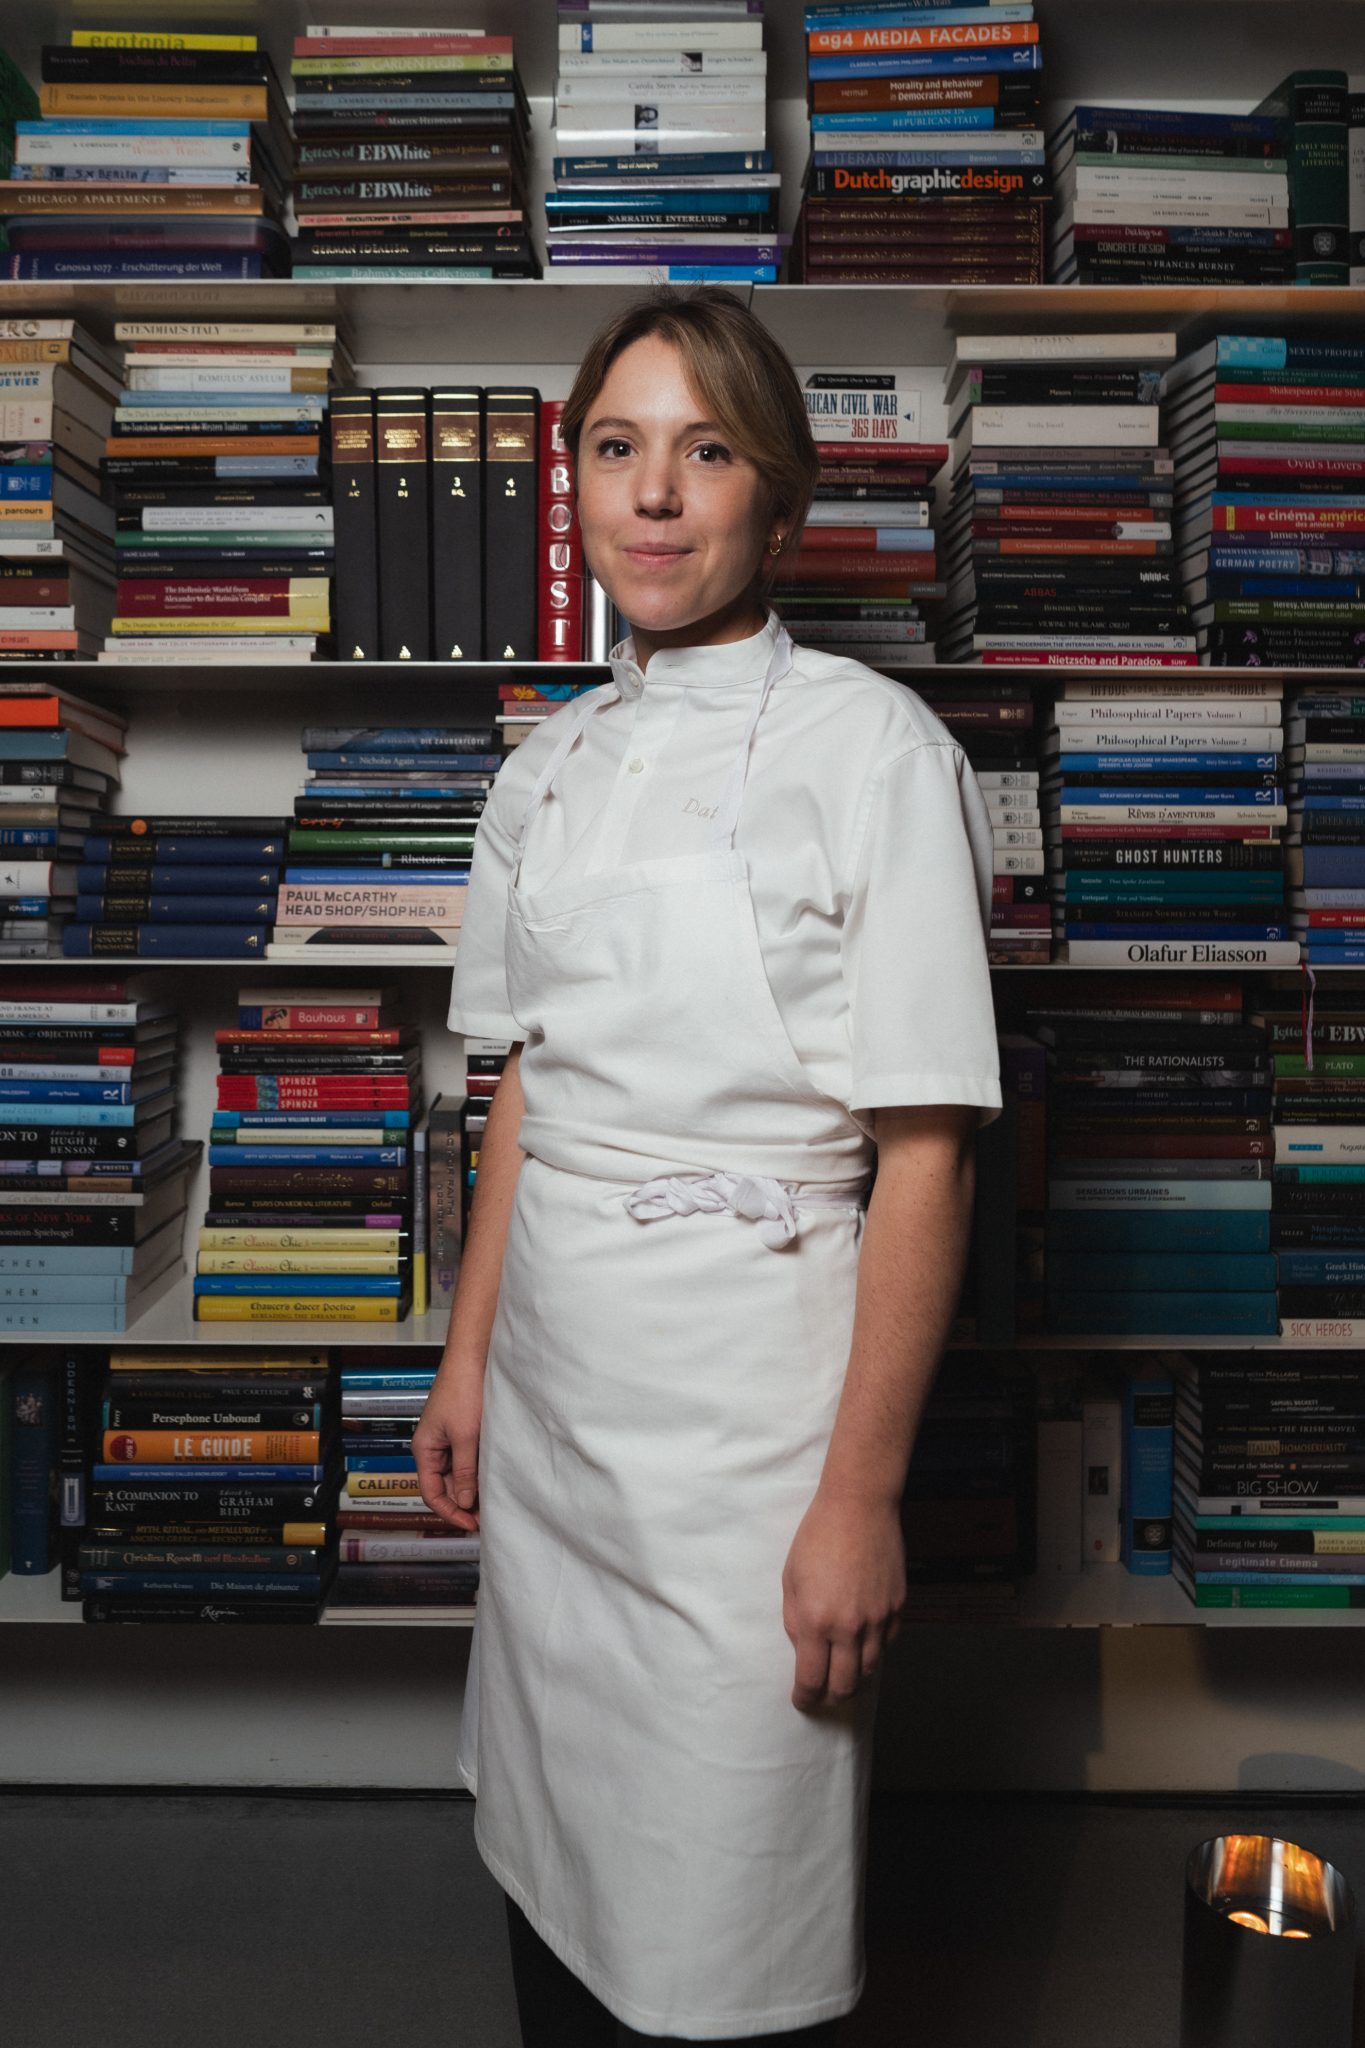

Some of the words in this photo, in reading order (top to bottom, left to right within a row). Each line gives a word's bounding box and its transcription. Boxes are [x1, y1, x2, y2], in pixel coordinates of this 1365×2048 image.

[819, 31, 854, 50] ag4
[863, 29, 923, 47] MEDIA
[929, 26, 1012, 45] FACADES
[889, 81, 924, 92] Morality
[924, 80, 941, 89] and
[941, 78, 984, 89] Behaviour
[898, 91, 942, 101] Democratic
[942, 89, 973, 99] Athens
[892, 116, 952, 128] REPUBLICAN
[953, 115, 979, 126] ITALY
[342, 145, 355, 159] of
[824, 153, 896, 165] LITERARY
[834, 167, 1024, 194] Dutchgraphicdesign
[343, 182, 356, 196] of
[17, 194, 77, 205] CHICAGO
[82, 194, 167, 205] APARTMENTS
[607, 214, 663, 224] NARRATIVE
[665, 214, 728, 224] INTERLUDES
[1097, 242, 1136, 253] CONCRETE
[1137, 243, 1166, 254] DESIGN
[54, 263, 91, 272] Canossa
[121, 262, 184, 275] Erschütterung
[184, 263, 200, 272] der
[201, 262, 222, 272] Welt
[1153, 259, 1197, 270] FRANCES
[1198, 261, 1236, 272] BURNEY
[191, 324, 221, 336] ITALY
[1324, 387, 1343, 398] Late
[1345, 388, 1364, 399] Style
[841, 393, 870, 416] CIVIL
[872, 393, 898, 415] WAR
[851, 419, 870, 438] 365
[871, 419, 898, 439] DAYS
[1287, 458, 1323, 470] Ovid's
[1326, 459, 1363, 471] Lovers
[399, 478, 407, 487] 2
[453, 476, 462, 487] 3
[506, 477, 516, 488] 4
[1255, 511, 1266, 522] le
[1268, 509, 1316, 522] cinéma
[1270, 531, 1298, 540] James
[1299, 531, 1325, 541] Joyce
[1215, 559, 1256, 569] GERMAN
[1258, 559, 1295, 569] POETRY
[1048, 654, 1090, 666] Nietzsche
[1092, 655, 1111, 666] and
[1113, 655, 1163, 667] Paradox
[1090, 708, 1162, 720] Philosophical
[1165, 708, 1203, 720] Papers
[1206, 711, 1236, 720] Volume
[1095, 734, 1167, 747] Philosophical
[1170, 735, 1208, 747] Papers
[1211, 738, 1239, 746] Volume
[1240, 738, 1248, 746] 2
[359, 756, 391, 766] Nicholas
[392, 757, 416, 767] Again
[400, 854, 447, 865] Rhetoric
[1115, 849, 1157, 864] GHOST
[1163, 849, 1223, 864] HUNTERS
[286, 890, 323, 902] PAUL
[324, 891, 398, 903] McCARTHY
[285, 905, 324, 917] HEAD
[325, 905, 408, 917] SHOP/SHOP
[408, 905, 447, 918] HEAD
[1127, 945, 1188, 963] Olafur
[1191, 946, 1267, 962] Eliasson
[297, 1011, 347, 1024] Bauhaus
[36, 1030, 95, 1039] OBJECTIVITY
[1124, 1054, 1146, 1067] THE
[1148, 1055, 1225, 1068] RATIONALISTS
[278, 1076, 318, 1087] SPINOZA
[280, 1087, 319, 1098] SPINOZA
[279, 1099, 319, 1109] SPINOZA
[21, 1131, 39, 1142] TO
[50, 1136, 80, 1146] HUGH
[50, 1145, 96, 1155] BENSON
[33, 1211, 61, 1223] NEW
[64, 1213, 93, 1223] YORK
[1290, 1321, 1312, 1337] SICK
[1315, 1321, 1353, 1337] HEROES
[113, 1409, 121, 1428] Perry
[151, 1412, 211, 1425] Persephone
[213, 1412, 264, 1424] Unbound
[173, 1437, 192, 1457] LE
[201, 1437, 253, 1457] GUIDE
[1236, 1479, 1263, 1495] BIG
[1266, 1479, 1319, 1495] SHOW
[183, 1491, 199, 1501] TO
[219, 1497, 274, 1507] GRAHAM
[104, 1502, 136, 1512] KANT
[219, 1507, 251, 1517] BIRD
[1206, 1539, 1242, 1552] Defining
[1244, 1541, 1258, 1549] the
[1259, 1540, 1279, 1553] Holy
[1219, 1556, 1276, 1571] Legitimate
[1279, 1557, 1319, 1568] Cinema
